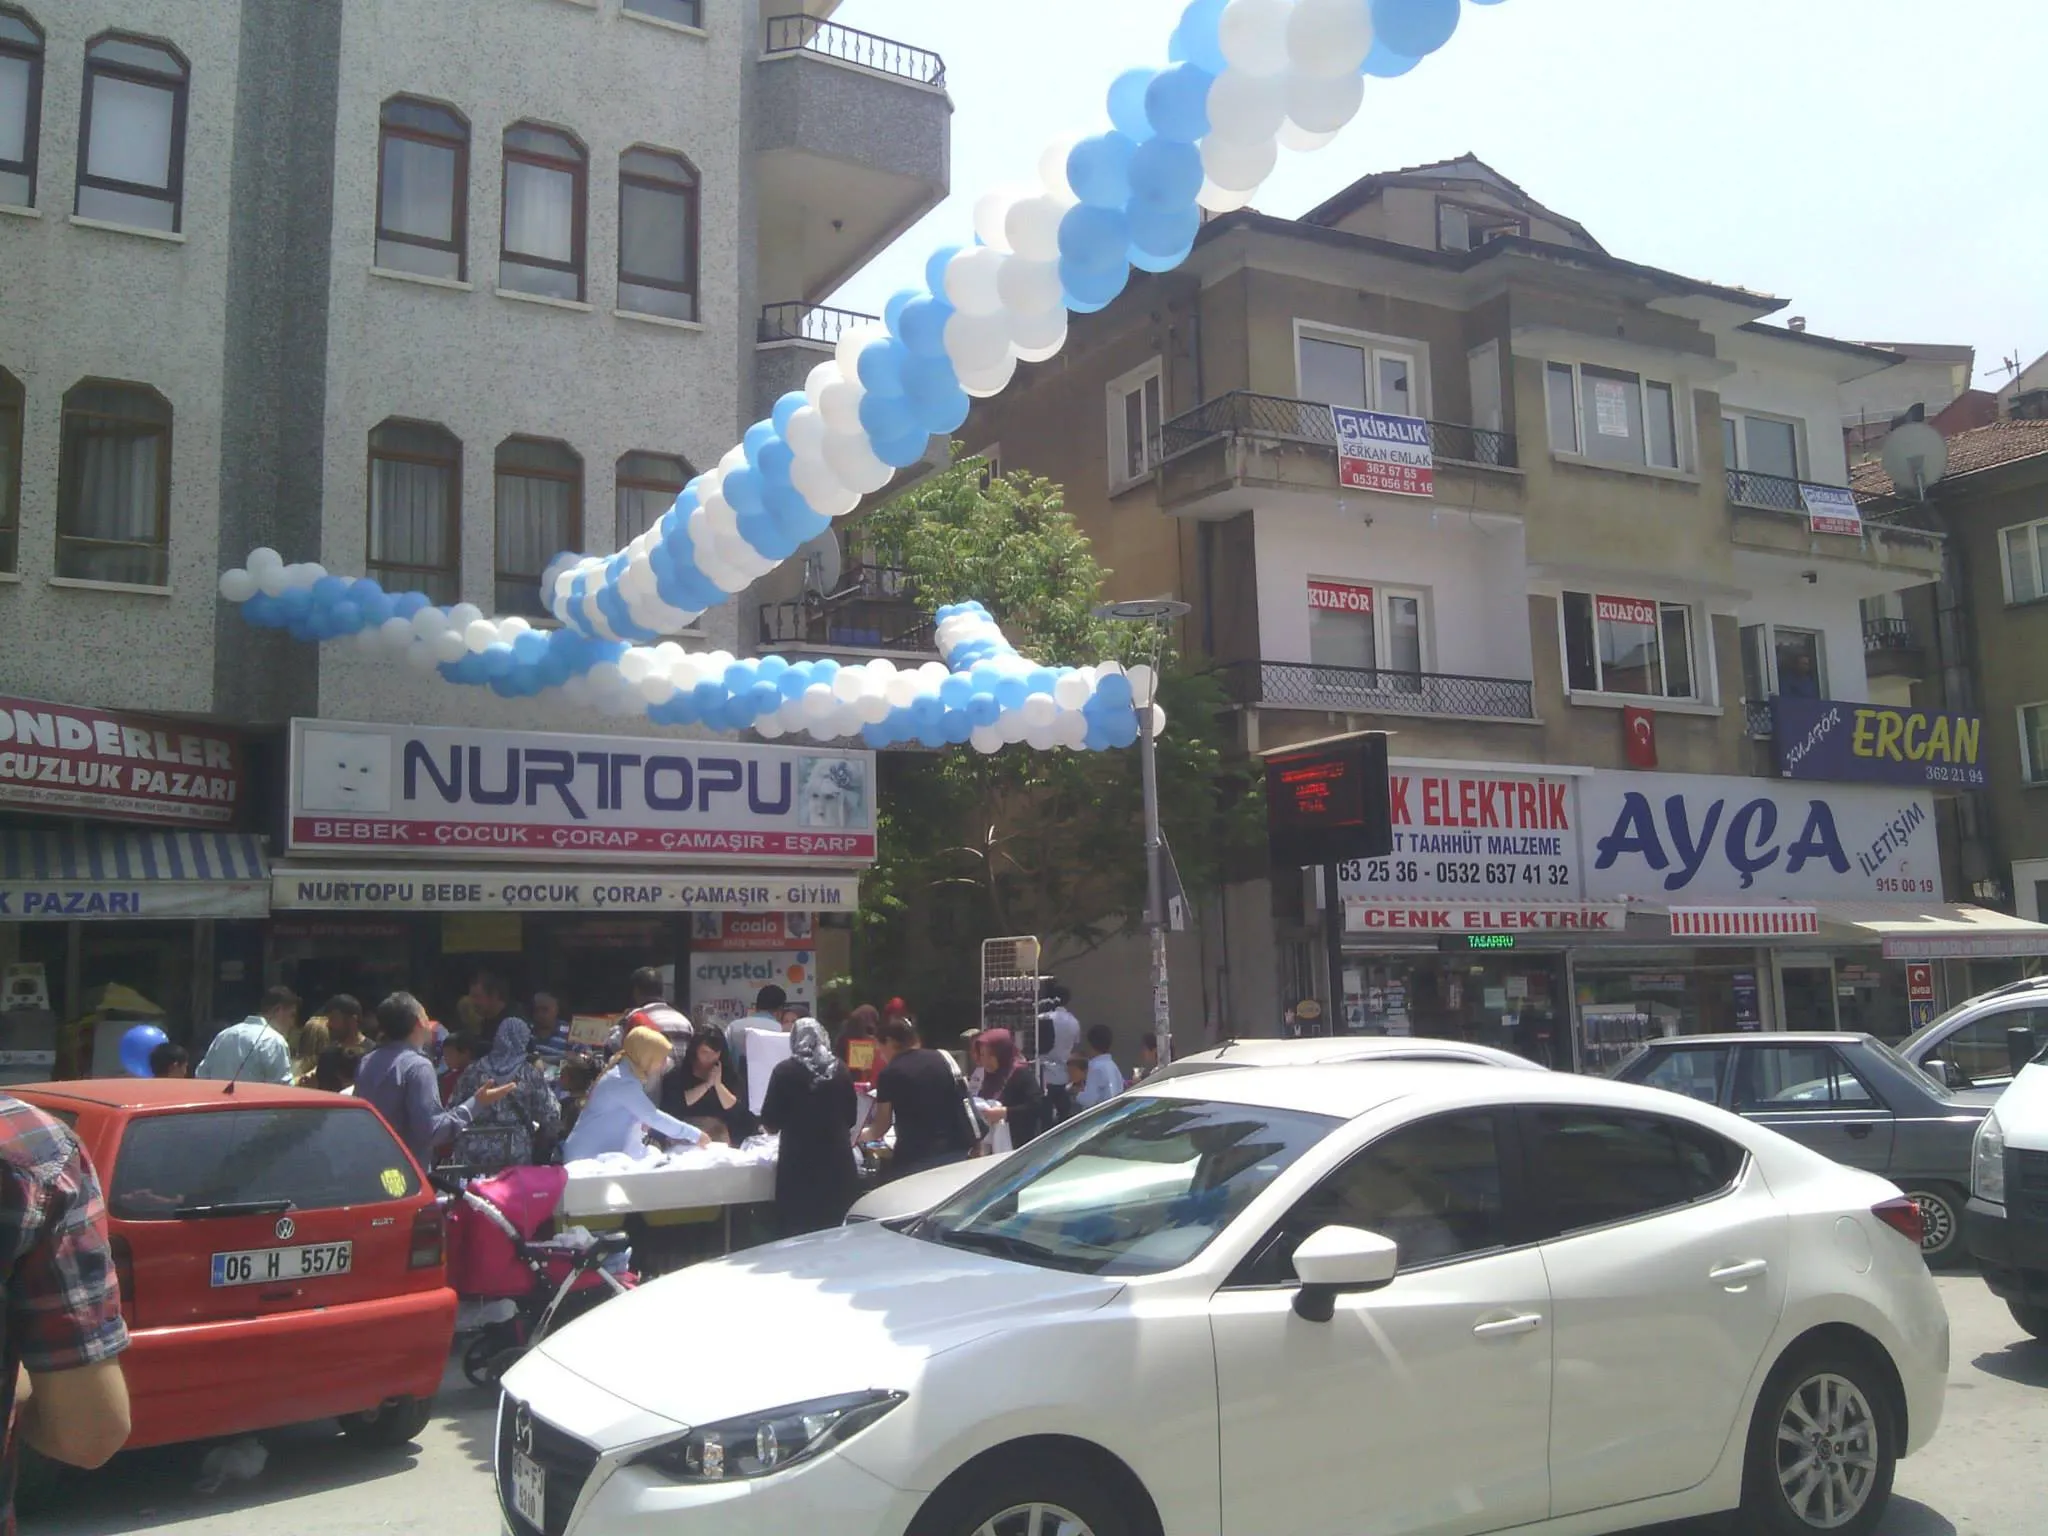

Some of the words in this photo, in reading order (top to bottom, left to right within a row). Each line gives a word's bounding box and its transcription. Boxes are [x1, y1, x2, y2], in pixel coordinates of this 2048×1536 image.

[1360, 415, 1426, 443] KİRALIK
[1343, 443, 1387, 461] SERKAN
[1390, 449, 1431, 467] EMLAK
[1353, 473, 1378, 486] 0532
[1403, 480, 1416, 491] 51
[1308, 588, 1370, 611] KUAFÖR
[1598, 601, 1655, 624] KUAFÖR
[1852, 709, 1980, 764] ERCAN
[0, 752, 121, 789] CUZLUK
[131, 767, 237, 802] PAZARI
[403, 739, 792, 820] NURTOPU
[1926, 767, 1949, 781] 362
[1951, 768, 1965, 781] 21
[1422, 777, 1568, 830] ELEKTRİK
[313, 822, 409, 840] BEBEK
[434, 825, 529, 845] ÇOCUK
[551, 829, 639, 848] ÇORAP
[660, 832, 765, 852] ÇAMAŞIR
[785, 835, 858, 854] EŞARP
[1409, 830, 1483, 855] TAAHHÜT
[1488, 836, 1561, 856] MALZEME
[1595, 791, 1851, 891] AYÇA
[1856, 802, 1925, 877] İLETİŞİM
[1339, 861, 1361, 881] 63
[1367, 861, 1390, 882] 25
[1396, 861, 1418, 882] 36
[1437, 863, 1480, 884] 0532
[1486, 864, 1516, 885] 637
[1522, 865, 1541, 885] 41
[1548, 865, 1568, 885] 32
[1876, 878, 1898, 892] 915
[1902, 878, 1916, 892] 00
[1920, 879, 1934, 892] 19
[23, 892, 139, 914] PAZARI
[298, 882, 413, 902] NURTOPU
[422, 884, 482, 902] BEBE
[502, 885, 579, 905] ÇOCUK
[593, 886, 663, 906] ÇORAP
[681, 886, 769, 907] ÇAMAŞIR
[787, 884, 841, 904] GİYİM
[1364, 910, 1451, 928] CENK
[1463, 908, 1609, 929] ELEKTRİK
[697, 959, 773, 985] crystal
[226, 1255, 251, 1281] 06
[267, 1253, 280, 1278] H
[301, 1246, 348, 1273] 5576
